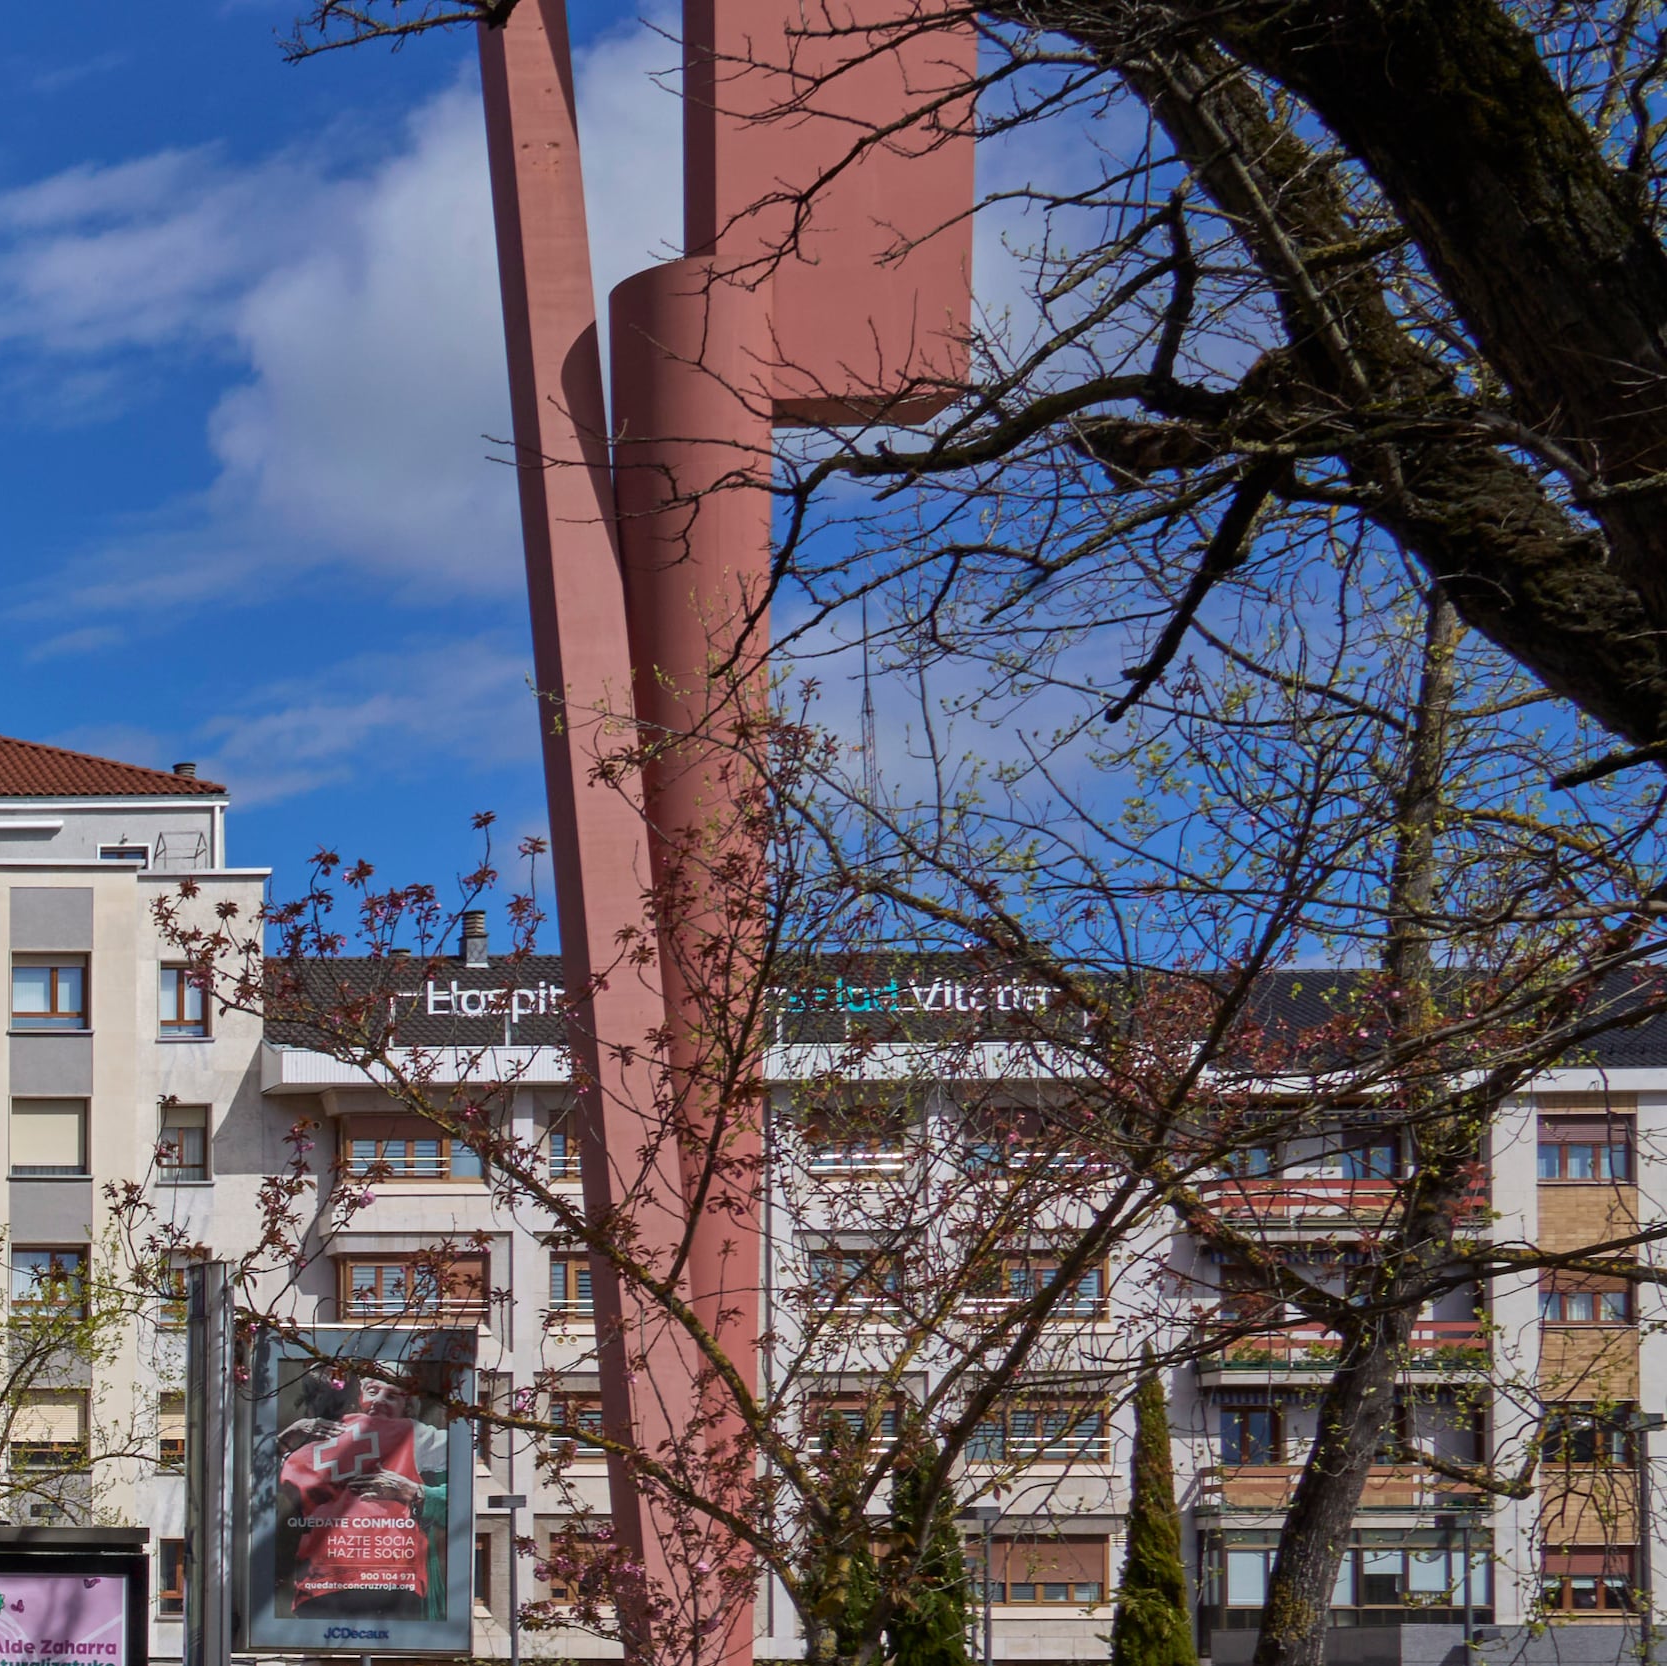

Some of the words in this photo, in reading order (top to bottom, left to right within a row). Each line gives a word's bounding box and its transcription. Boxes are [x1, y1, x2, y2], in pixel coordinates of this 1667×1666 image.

[352, 1517, 415, 1529] CONMIGO
[327, 1535, 371, 1546] HAZTE
[374, 1535, 415, 1546] SOCIA
[327, 1548, 371, 1559] HAZTE
[374, 1548, 415, 1559] SOCIO
[360, 1572, 379, 1581] 900
[382, 1572, 398, 1581] 104
[400, 1572, 416, 1581] 971
[304, 1580, 416, 1592] quedateconcruzroja.org
[323, 1627, 390, 1641] JCDecaux
[40, 1639, 117, 1655] Zaharra
